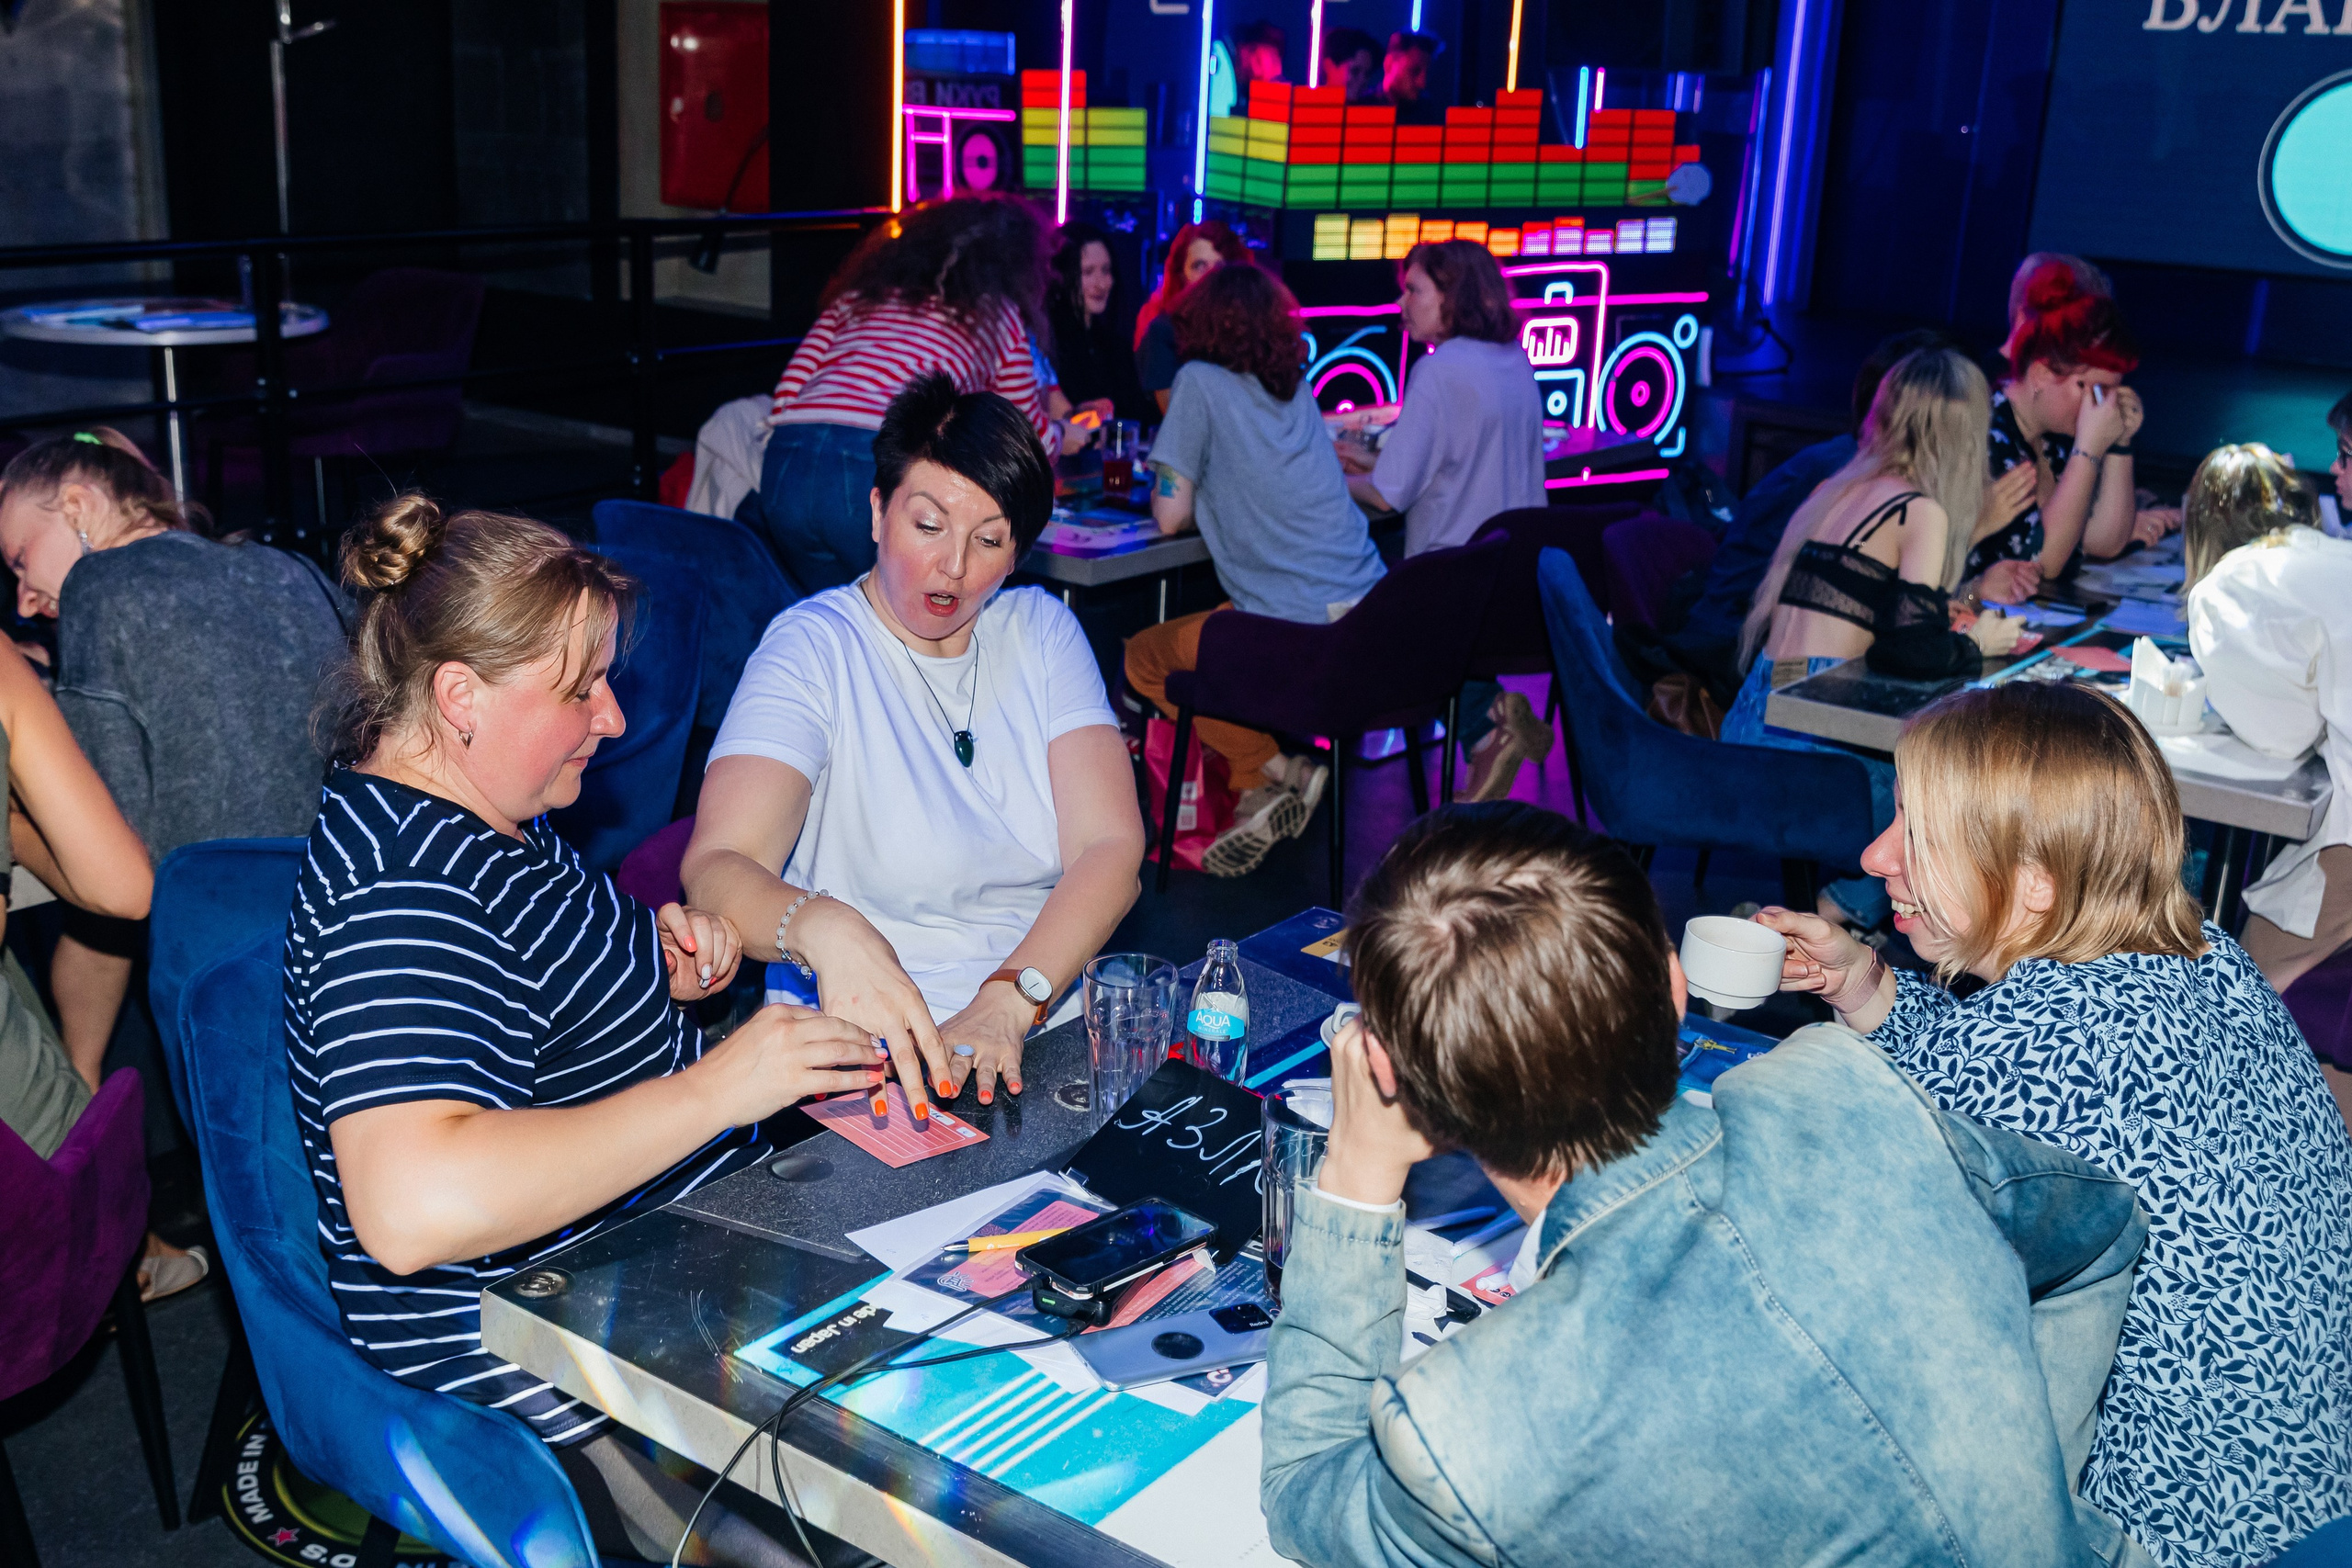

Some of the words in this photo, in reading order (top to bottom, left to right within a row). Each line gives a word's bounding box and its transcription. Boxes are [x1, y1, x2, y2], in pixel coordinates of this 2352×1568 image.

[1195, 1010, 1231, 1029] AQUA
[1197, 1025, 1227, 1034] MINERALE
[853, 1304, 879, 1319] de
[838, 1315, 862, 1328] in
[790, 1324, 842, 1354] Japan
[240, 1433, 268, 1458] IN
[236, 1459, 274, 1525] MADE
